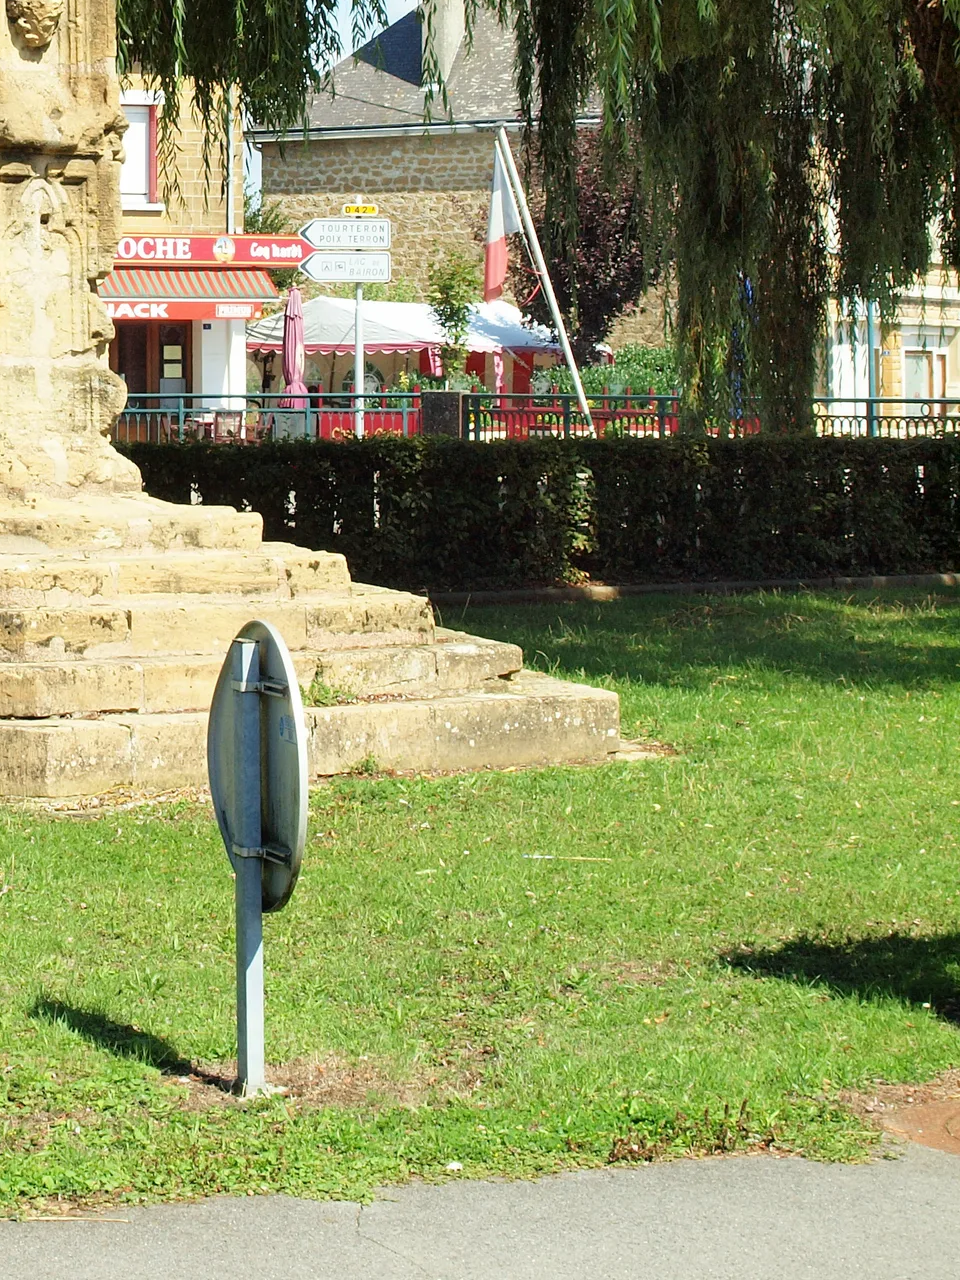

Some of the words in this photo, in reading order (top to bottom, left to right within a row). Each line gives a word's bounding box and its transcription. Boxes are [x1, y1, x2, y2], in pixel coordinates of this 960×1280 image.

[321, 224, 385, 233] TOURTERON
[319, 235, 342, 243] POIX
[348, 235, 385, 243] TERRON
[114, 237, 192, 260] OCHE
[250, 242, 270, 260] Coq
[349, 268, 385, 276] BAIRON
